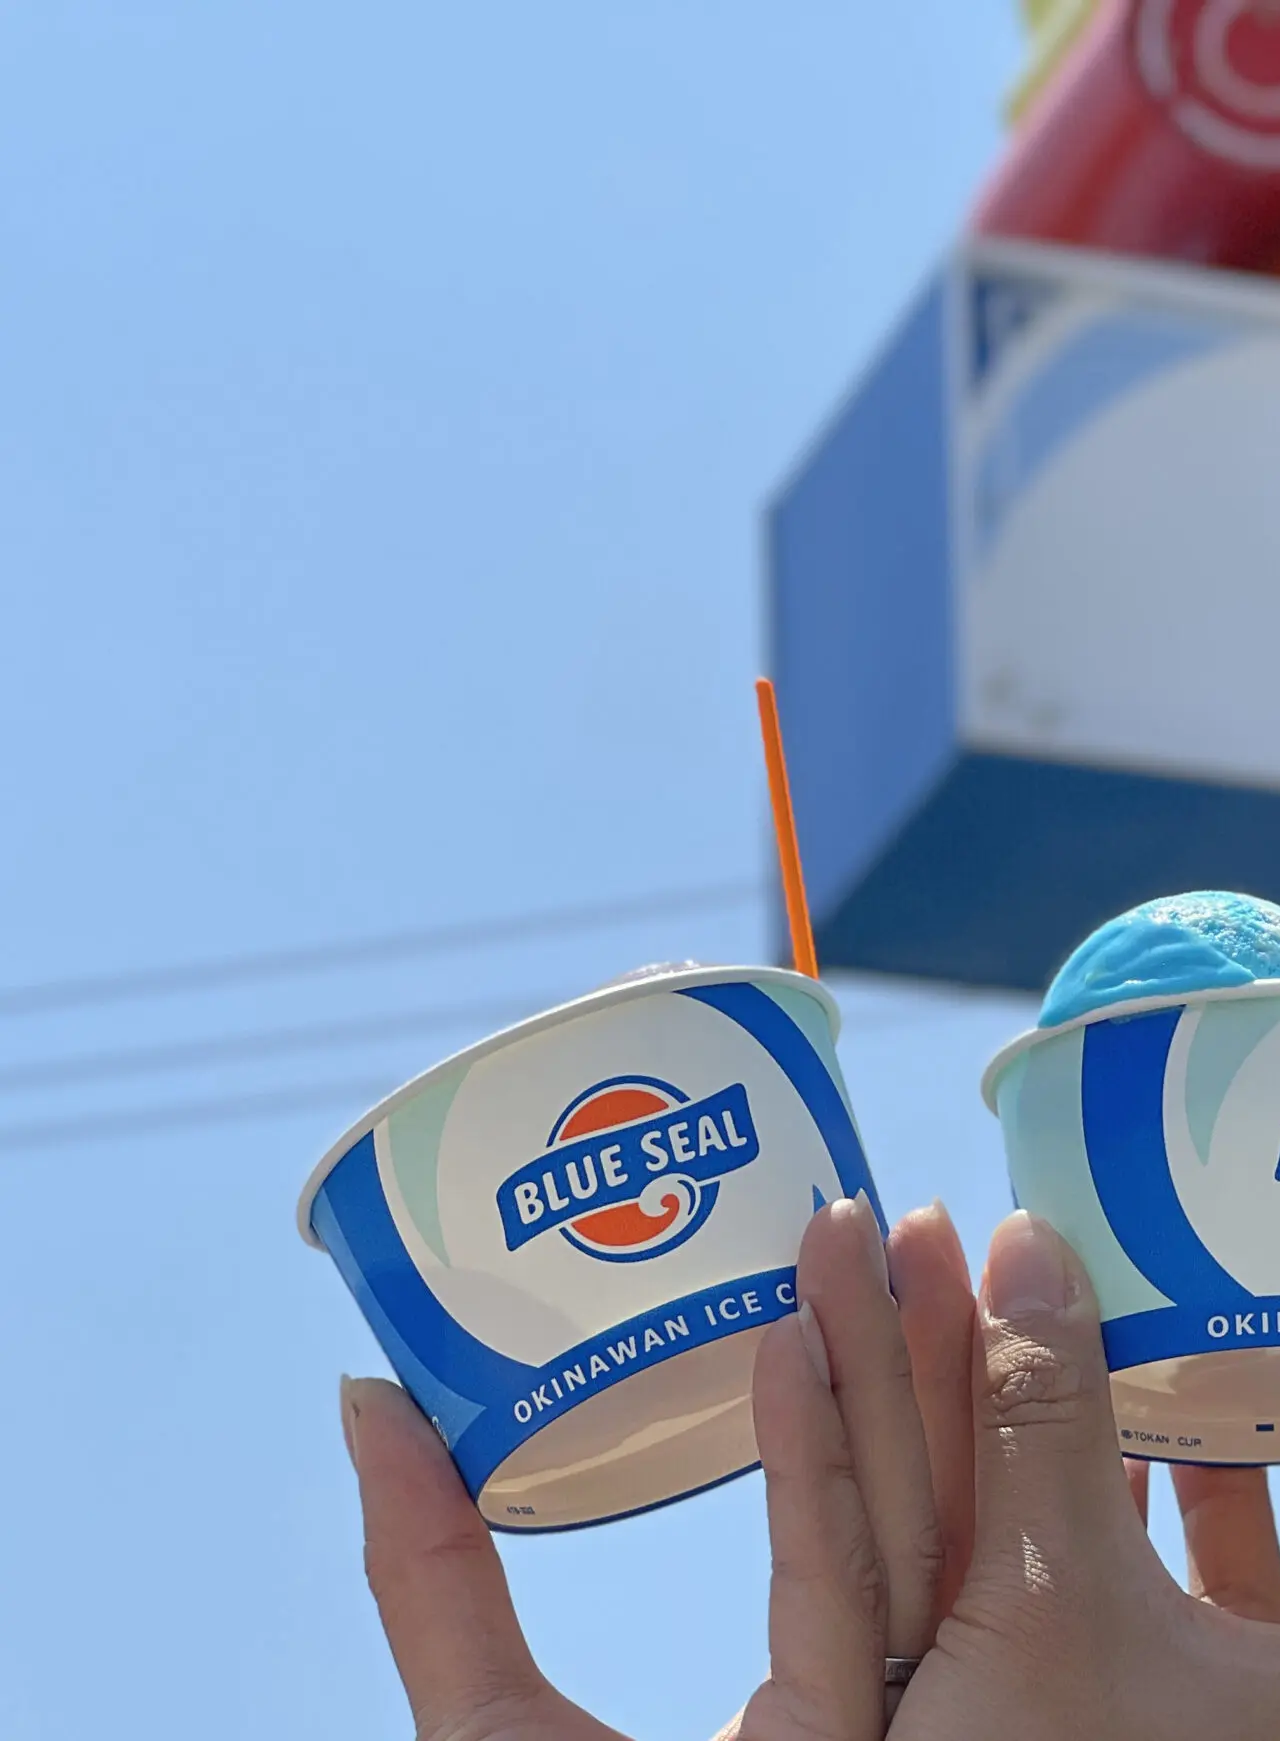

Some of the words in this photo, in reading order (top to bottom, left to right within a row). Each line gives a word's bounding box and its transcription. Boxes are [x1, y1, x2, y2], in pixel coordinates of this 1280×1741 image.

[514, 1144, 628, 1225] BLUE
[641, 1110, 747, 1171] SEAL
[513, 1315, 690, 1423] OKINAWAN
[704, 1291, 762, 1326] ICE
